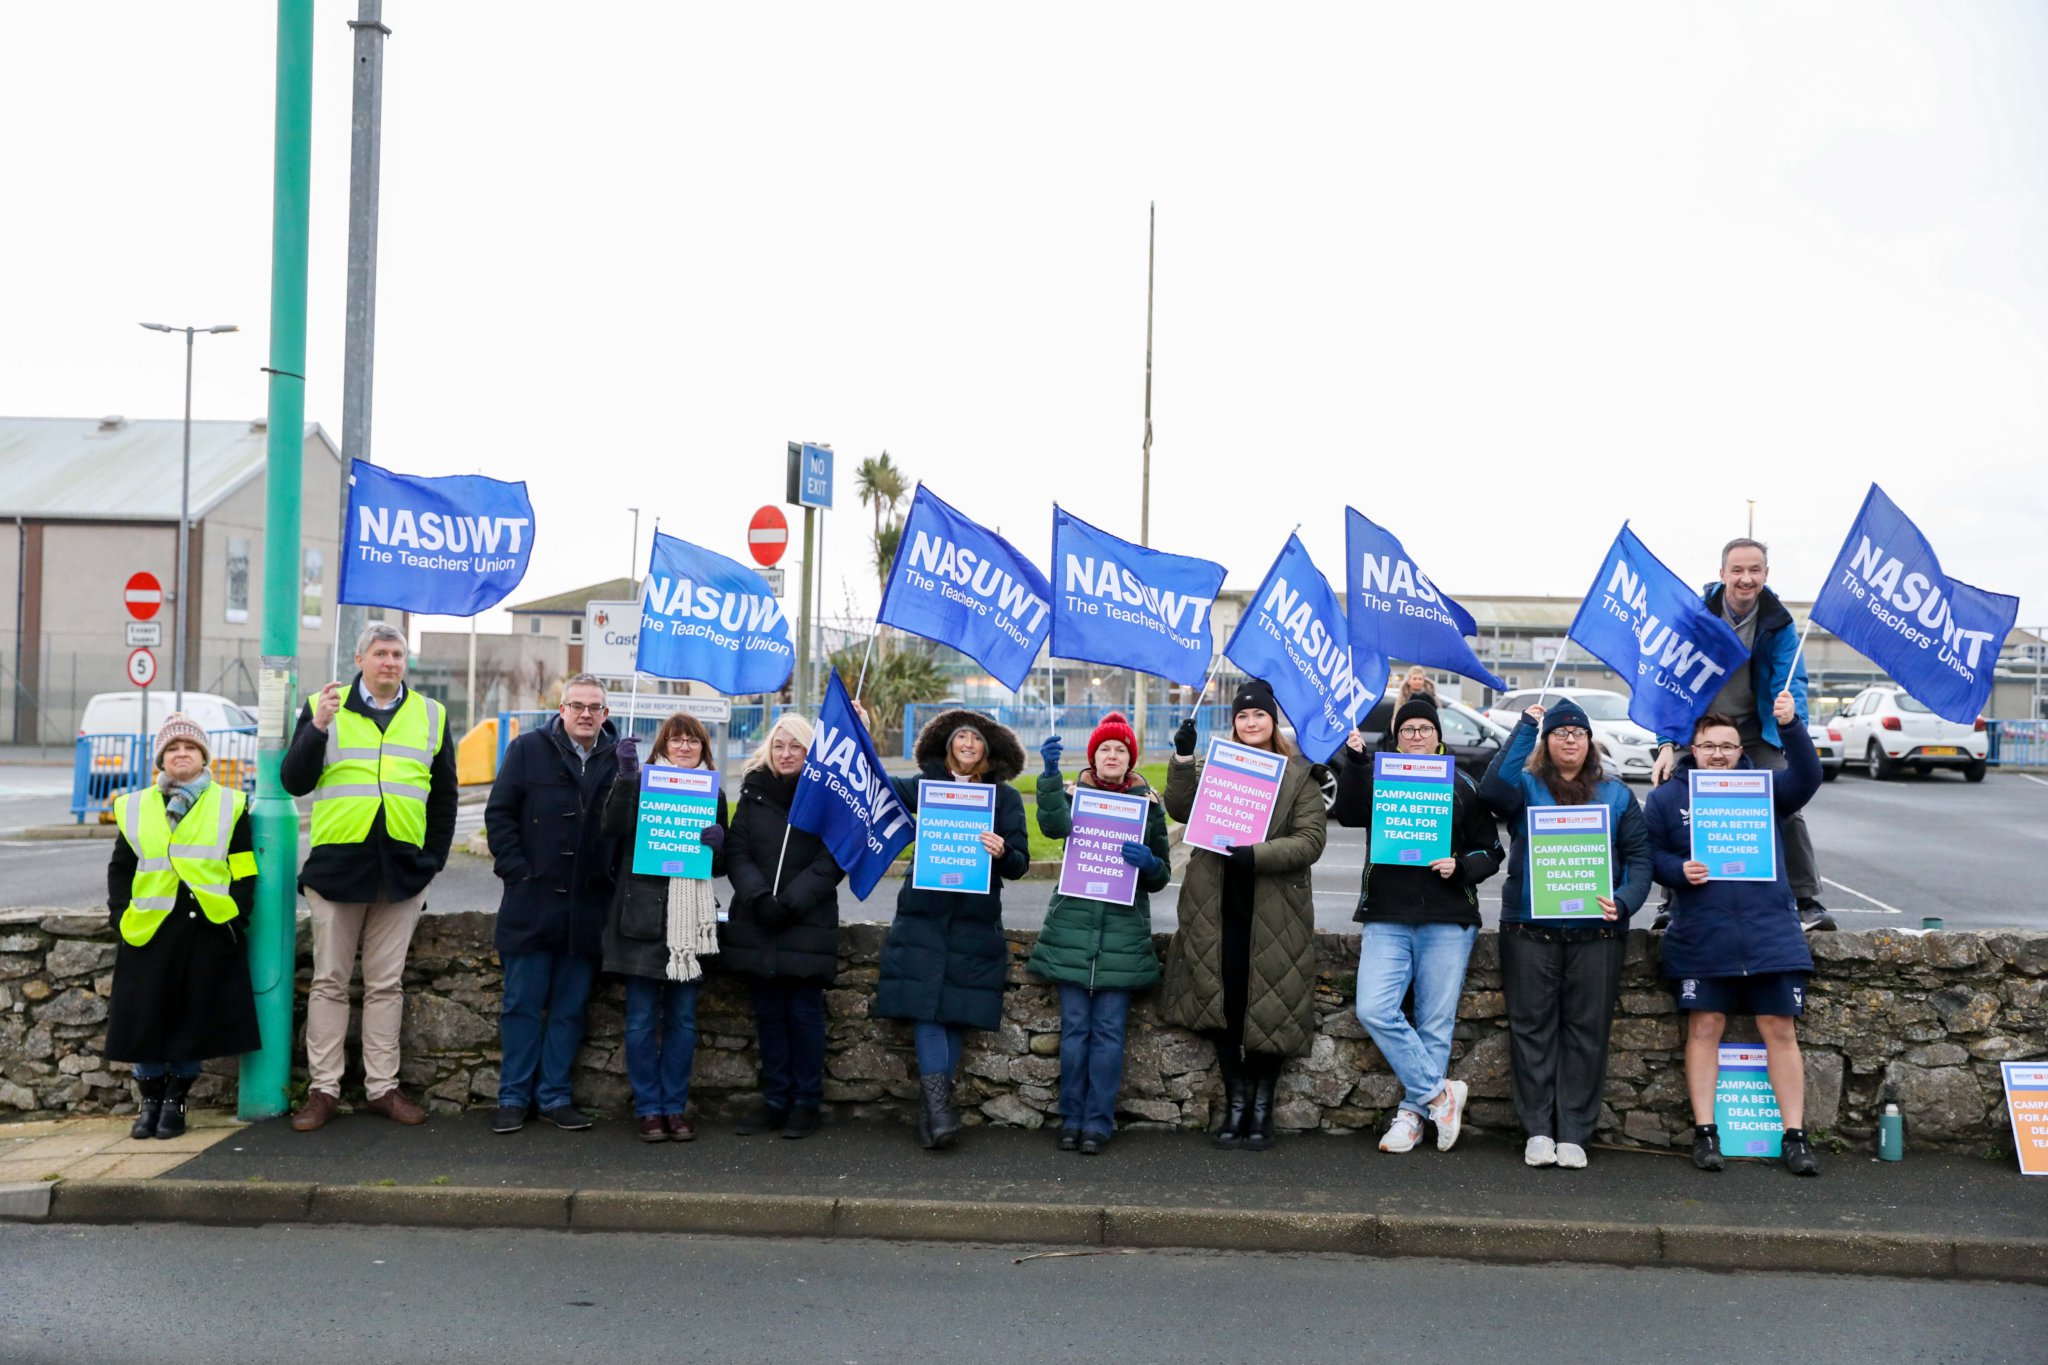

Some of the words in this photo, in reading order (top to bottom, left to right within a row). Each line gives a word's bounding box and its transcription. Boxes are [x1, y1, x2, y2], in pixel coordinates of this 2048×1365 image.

[811, 457, 825, 475] NO
[808, 477, 827, 497] EXIT
[359, 506, 529, 553] NASUWT
[359, 546, 392, 563] The
[398, 551, 473, 571] Teachers'
[475, 557, 515, 572] Union
[908, 531, 1050, 633] NASUWT
[1066, 554, 1212, 633] NASUWT
[644, 573, 793, 643] NASUW
[905, 569, 935, 591] The
[939, 581, 994, 616] Teachers'
[994, 612, 1030, 650] Union
[1066, 596, 1098, 614] The
[1362, 593, 1391, 612] The
[1850, 535, 1995, 670] NASUWT
[1607, 559, 1725, 694] NAUWT
[1841, 570, 1865, 599] The
[1867, 595, 1939, 650] Teachers'
[1938, 649, 1974, 684] Union
[605, 631, 638, 646] Cast
[670, 621, 744, 651] Teachers'
[745, 636, 790, 656] Union
[1258, 612, 1282, 641] The
[1284, 636, 1327, 696] Teachers'
[1263, 577, 1376, 719] NASUWT
[1603, 594, 1629, 622] The
[1654, 670, 1694, 707] Union
[137, 659, 146, 675] 5
[688, 705, 724, 713] RECEPTION
[807, 718, 914, 840] NASUWT
[1205, 775, 1273, 800] CAMPAIGNING
[1203, 788, 1223, 799] FOR
[1224, 794, 1231, 802] A
[1233, 797, 1268, 812] BETTER
[1374, 789, 1451, 802] CAMPAIGNING
[640, 800, 715, 816] CAMPAIGNING
[1209, 802, 1233, 815] DEAL
[1235, 809, 1255, 821] FOR
[1375, 803, 1397, 812] FOR
[1399, 804, 1408, 812] A
[1410, 805, 1449, 815] BETTER
[1695, 808, 1769, 817] CAMPAIGNING
[641, 814, 662, 824] FOR
[664, 817, 672, 825] A
[674, 817, 712, 828] BETTER
[922, 818, 989, 830] CAMPAIGNING
[1205, 814, 1253, 834] TEACHERS
[1385, 817, 1413, 826] DEAL
[1415, 819, 1438, 828] FOR
[1697, 821, 1718, 829] FOR
[1720, 821, 1728, 829] A
[1729, 821, 1767, 829] BETTER
[650, 828, 677, 839] DEAL
[679, 831, 701, 841] FOR
[923, 831, 942, 839] FOR
[944, 832, 951, 840] A
[952, 833, 982, 842] BETTE
[1072, 825, 1139, 842] CAMPAIGNING
[1383, 830, 1438, 841] TEACHERS
[1708, 833, 1734, 841] DEAL
[1736, 833, 1758, 841] FOR
[648, 841, 701, 854] TEACHERS
[931, 844, 955, 853] DEAL
[957, 846, 977, 854] FOR
[1072, 838, 1091, 848] FOR
[1093, 841, 1100, 849] A
[1102, 843, 1123, 852] BETT
[1534, 844, 1606, 854] CAMPAIGNING
[1706, 845, 1759, 854] TEACHERS
[929, 856, 977, 867] TEACHERS
[1080, 851, 1103, 862] DEAL
[1105, 856, 1124, 865] FOR
[1536, 858, 1557, 866] FOR
[1559, 858, 1566, 866] A
[1568, 857, 1605, 866] BETTER
[1077, 863, 1124, 878] TEACHERS
[1546, 871, 1572, 879] DEAL
[1575, 870, 1596, 878] FOR
[1546, 883, 1597, 892] TEACHERS
[1716, 1094, 1739, 1103] FOR
[1741, 1095, 1749, 1103] A
[1751, 1095, 1776, 1104] BETT
[1728, 1108, 1756, 1117] DEAL
[1758, 1108, 1781, 1118] FOR
[2018, 1114, 2040, 1122] FOR
[1728, 1122, 1784, 1131] TEACHERS
